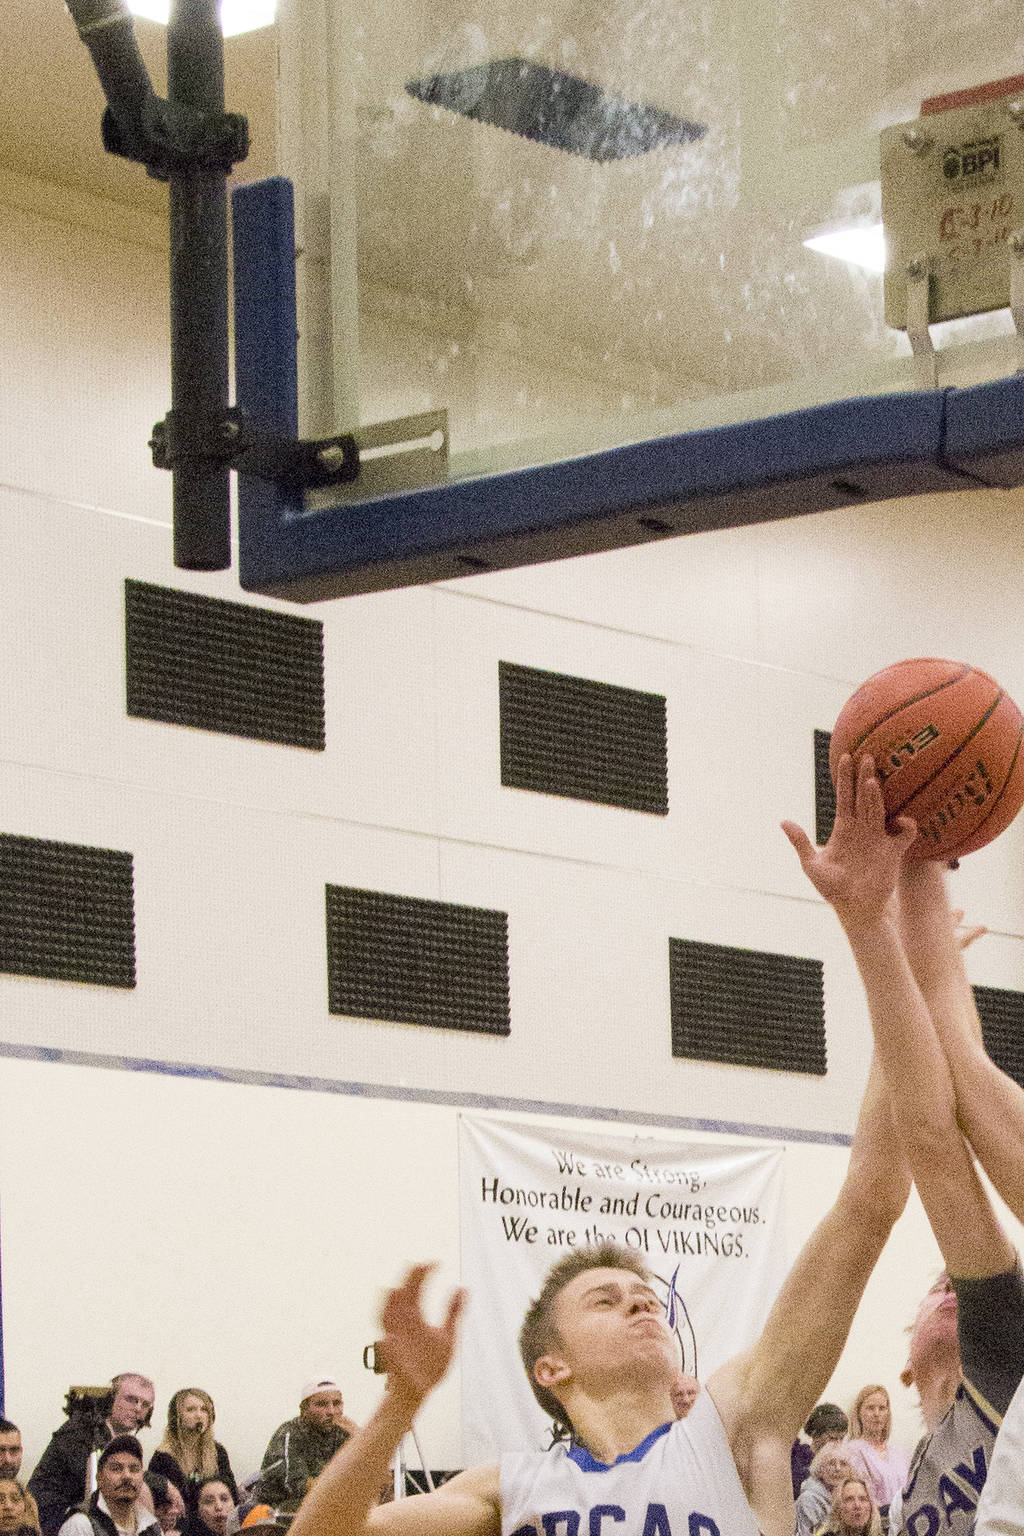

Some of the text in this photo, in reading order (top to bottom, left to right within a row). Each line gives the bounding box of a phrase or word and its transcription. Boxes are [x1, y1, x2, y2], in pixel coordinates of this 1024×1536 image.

[552, 1150, 586, 1178] We
[594, 1161, 624, 1179] are
[481, 1177, 767, 1229] Honorable and Courageous.
[501, 1216, 538, 1244] We
[547, 1228, 577, 1247] are
